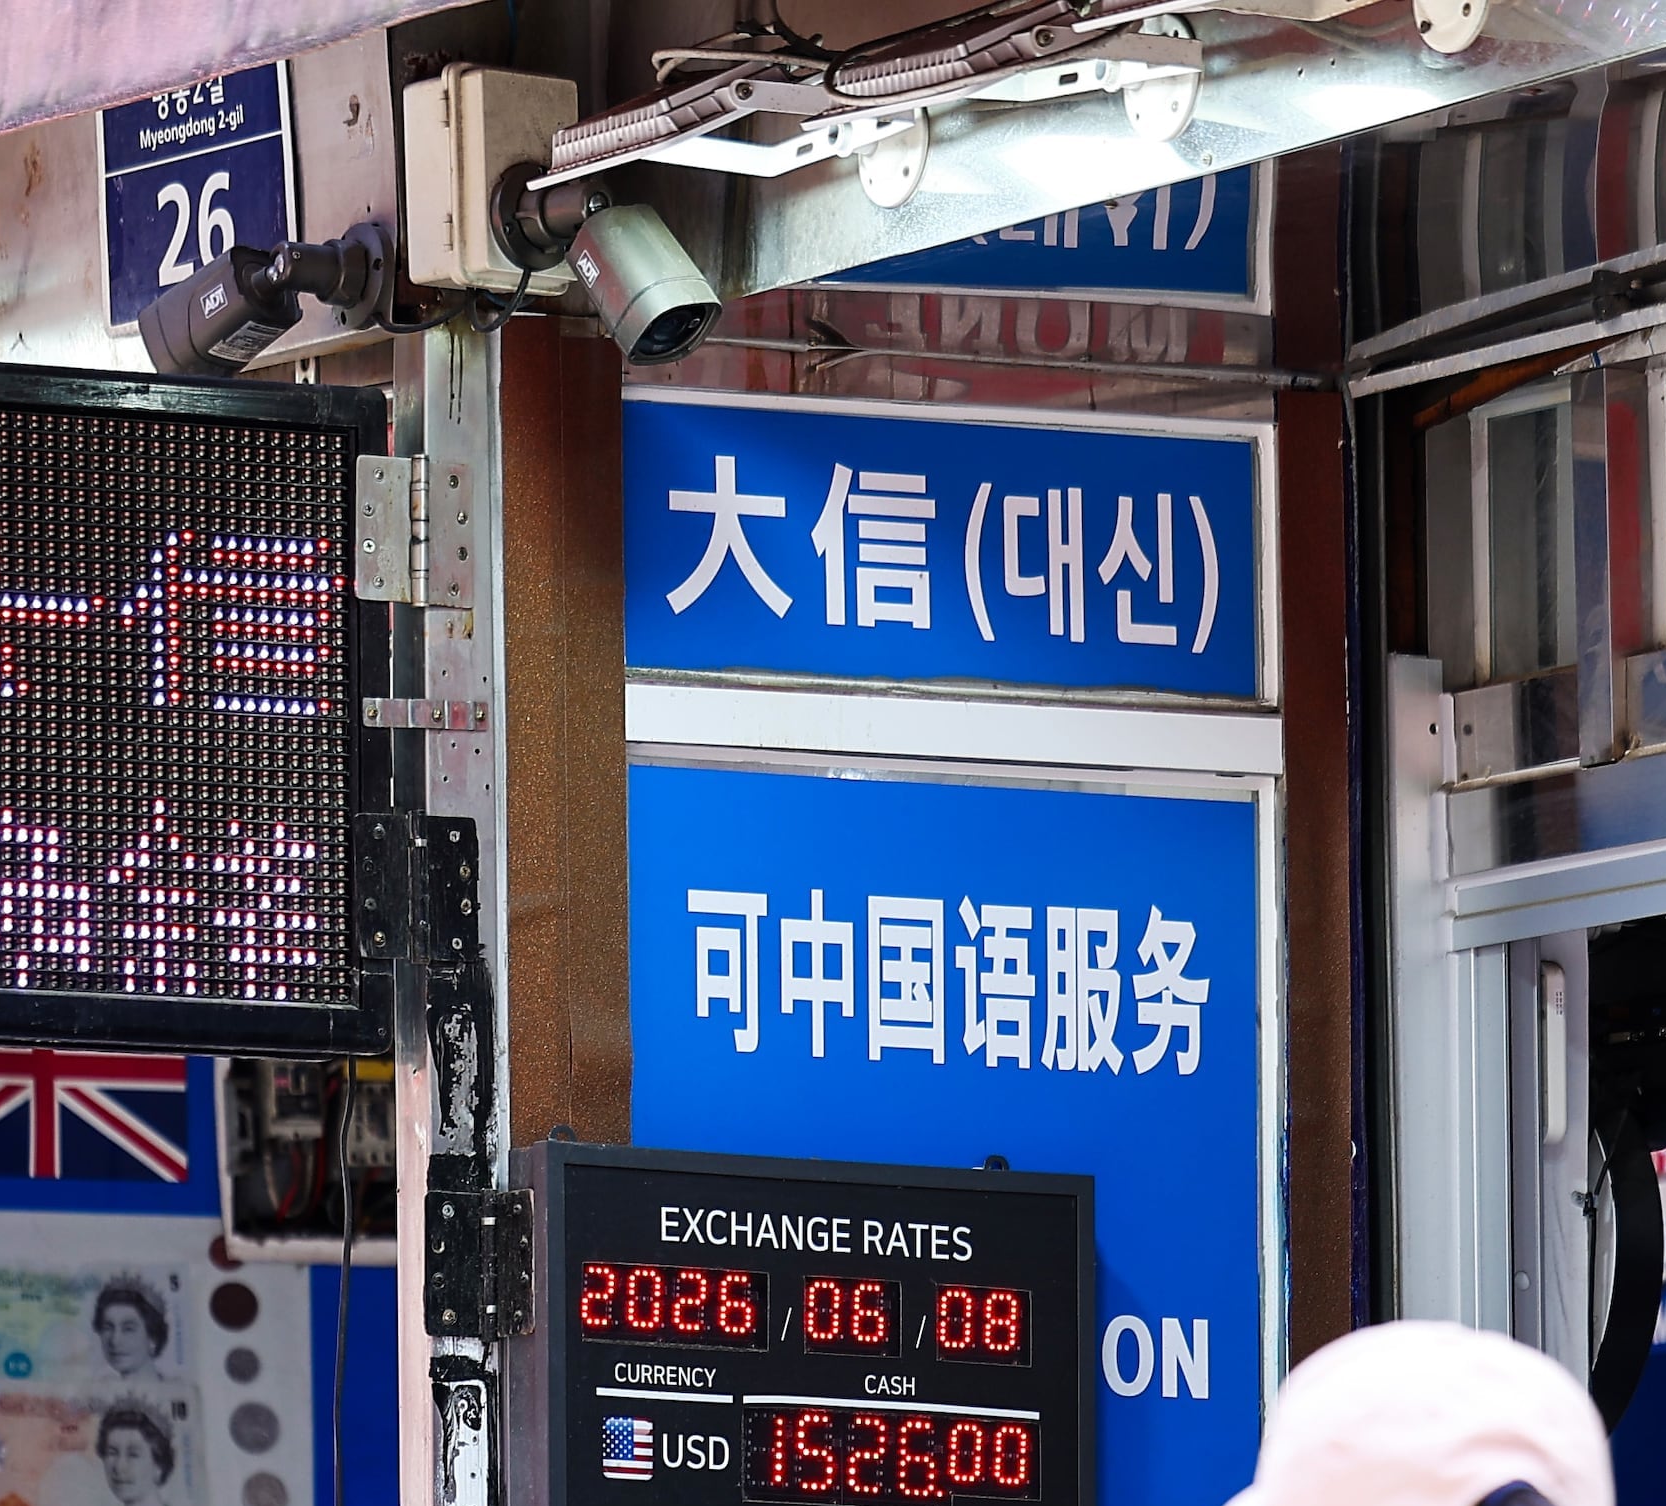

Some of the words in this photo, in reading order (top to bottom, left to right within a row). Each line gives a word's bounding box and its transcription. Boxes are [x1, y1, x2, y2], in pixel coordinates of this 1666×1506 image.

[139, 116, 215, 151] Myeongdong
[218, 104, 245, 132] 2-gil
[156, 171, 236, 288] 26
[576, 253, 596, 287] ADT
[203, 289, 226, 313] ADT
[687, 887, 1211, 1077] 可中国语服务
[660, 1206, 851, 1256] EXCHANGE
[862, 1219, 973, 1262] RATES
[580, 1265, 754, 1335] 2026
[805, 1279, 885, 1345] 06
[937, 1289, 1018, 1353] 08
[613, 1362, 717, 1390] CURRENCY
[864, 1373, 917, 1398] CASH
[662, 1434, 731, 1472] USD
